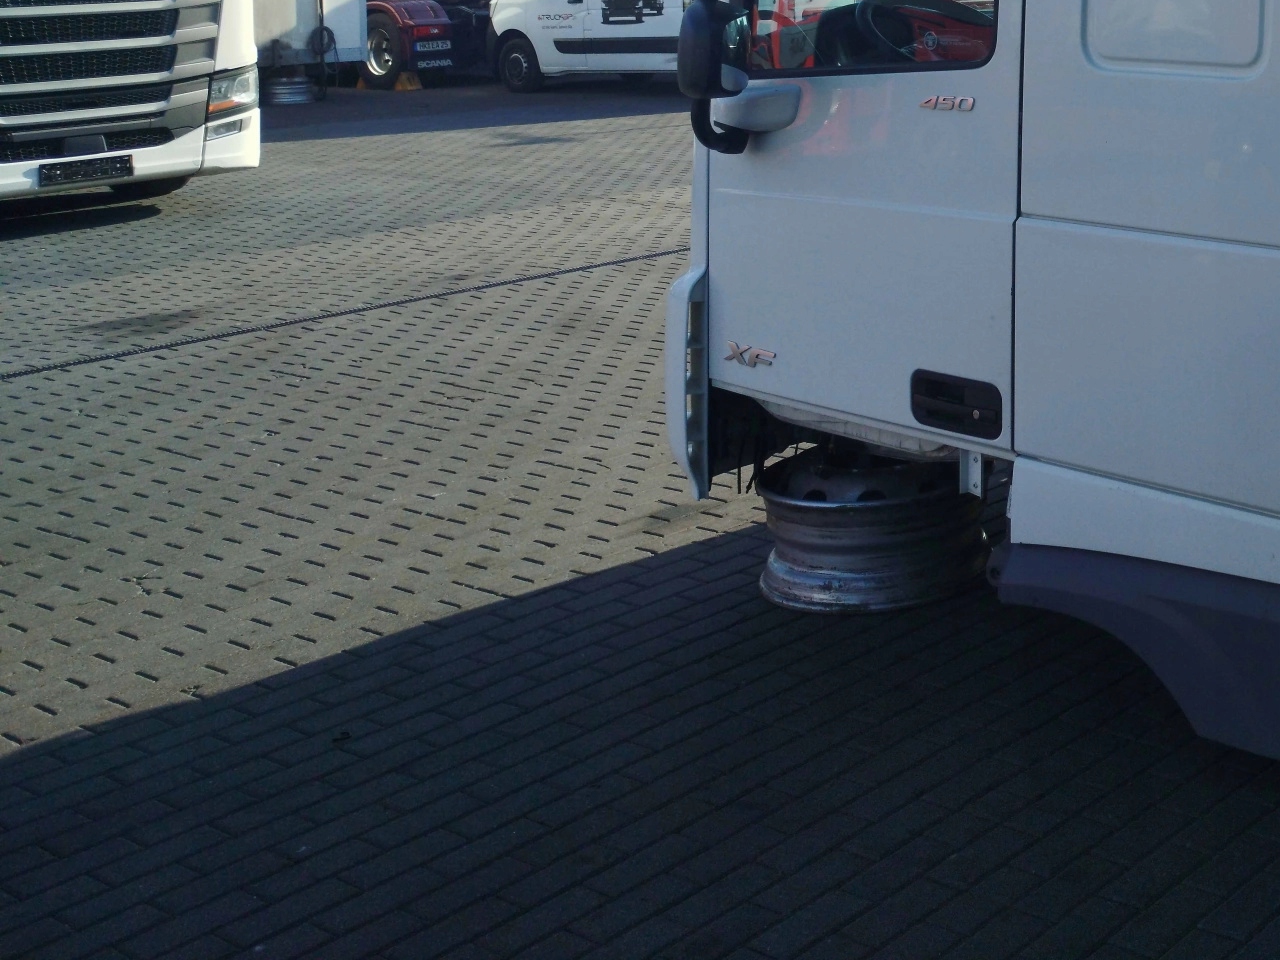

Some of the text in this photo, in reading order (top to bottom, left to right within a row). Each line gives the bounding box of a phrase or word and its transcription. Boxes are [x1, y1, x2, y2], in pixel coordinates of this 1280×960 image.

[417, 59, 452, 68] SCANIA
[919, 95, 976, 112] 450
[723, 340, 777, 368] XF
